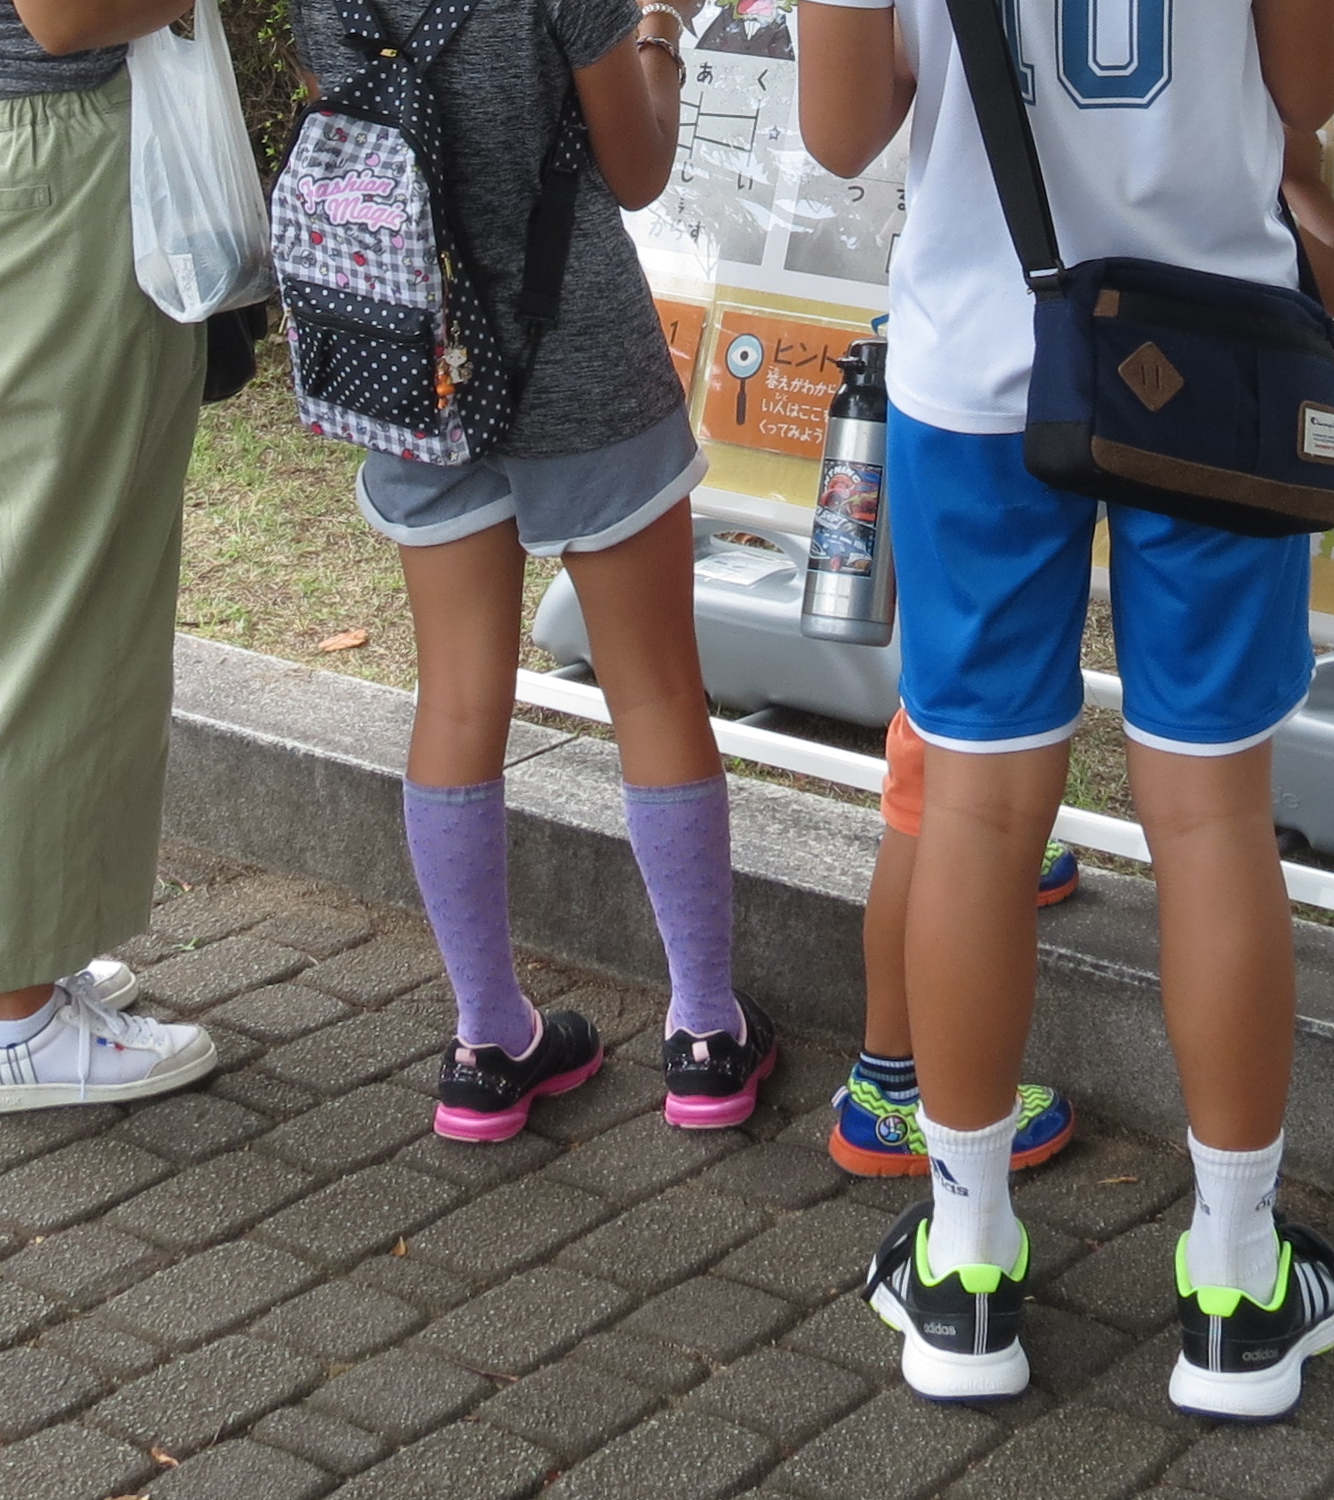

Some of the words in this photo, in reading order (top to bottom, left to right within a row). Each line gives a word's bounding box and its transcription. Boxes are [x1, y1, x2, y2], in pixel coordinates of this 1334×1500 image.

[697, 62, 713, 85] あ
[757, 68, 768, 91] く
[299, 170, 395, 213] Fashion
[737, 173, 754, 190] い
[848, 185, 865, 202] つ
[326, 197, 407, 232] Magic
[759, 418, 824, 444] くってみよう
[924, 1322, 957, 1336] adidas
